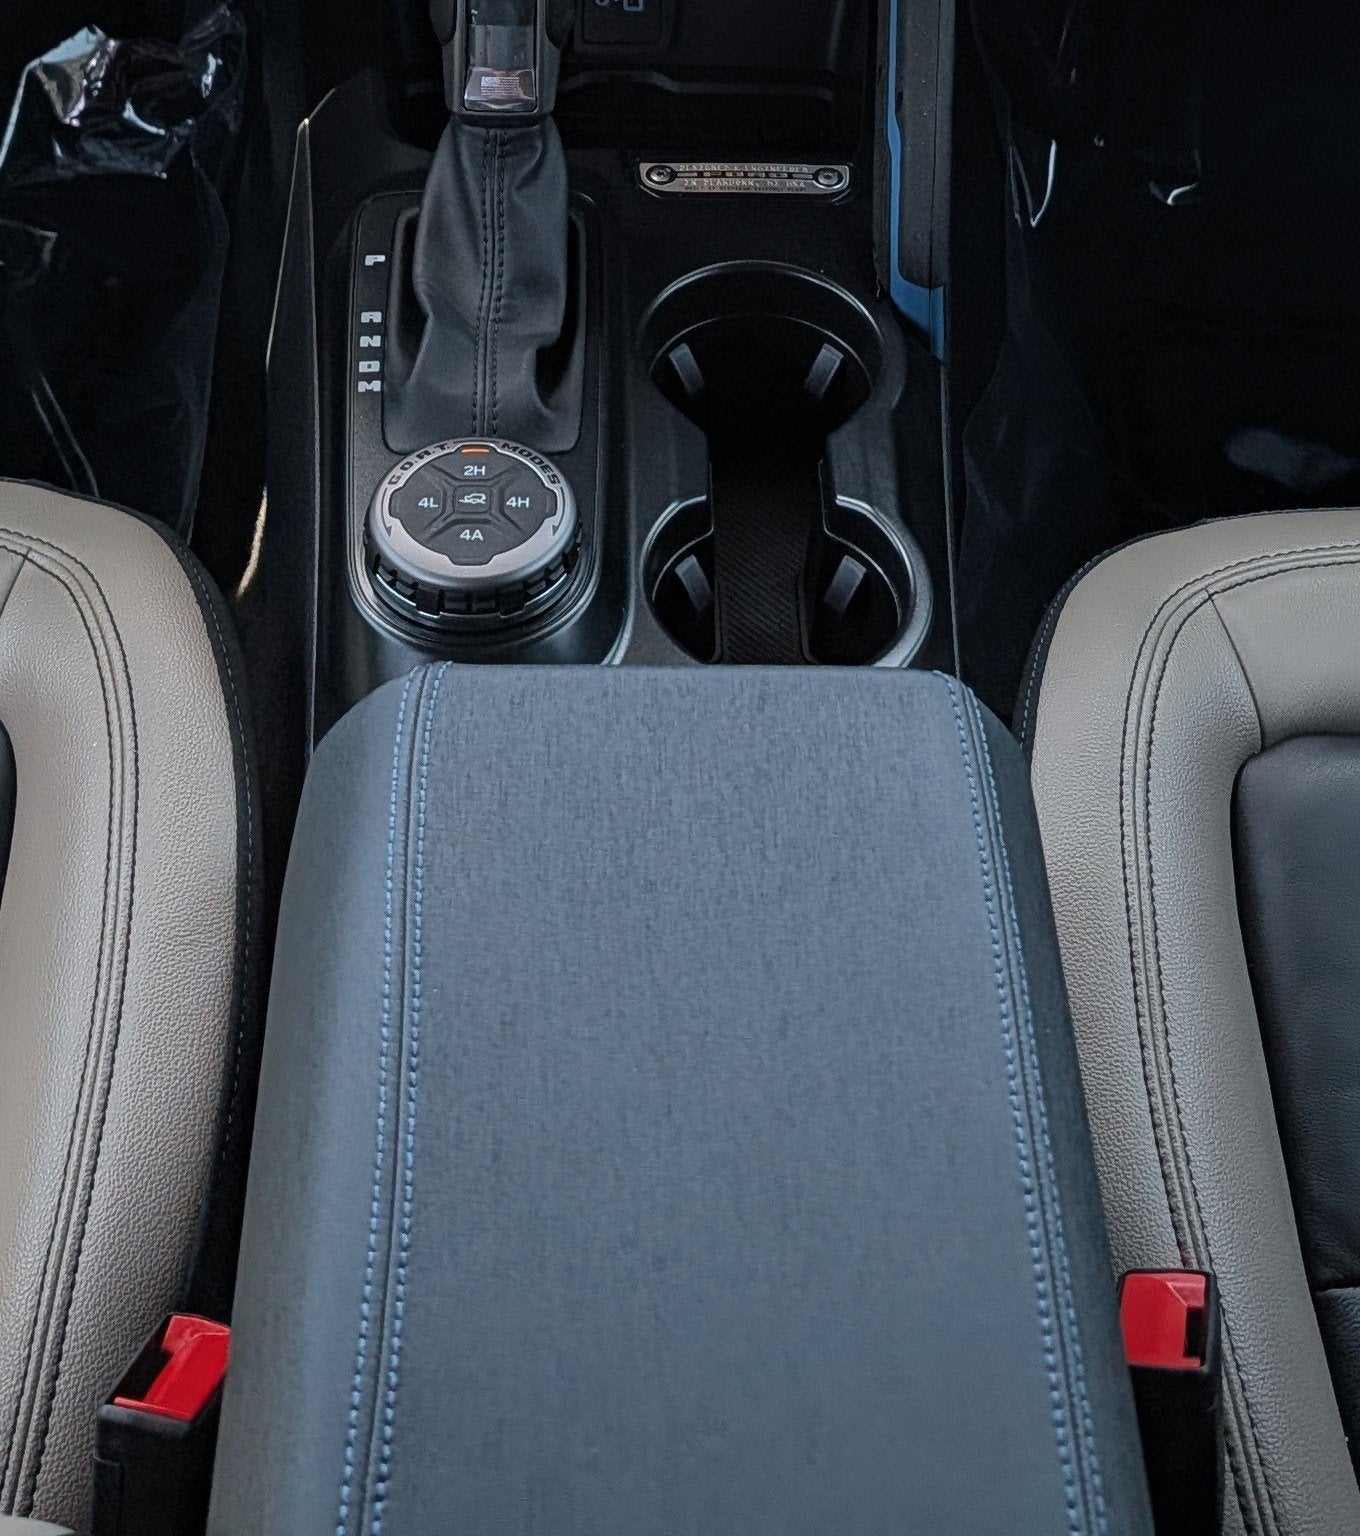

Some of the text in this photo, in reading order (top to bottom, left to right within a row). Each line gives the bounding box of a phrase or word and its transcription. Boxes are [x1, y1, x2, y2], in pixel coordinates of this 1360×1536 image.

[364, 254, 386, 266] P
[359, 335, 381, 348] N
[358, 360, 380, 373] D
[357, 379, 381, 393] M
[500, 441, 561, 485] MODES
[463, 465, 486, 476] 2H
[417, 497, 438, 508] 4L
[505, 496, 530, 508] 4H
[459, 529, 484, 541] 4A
